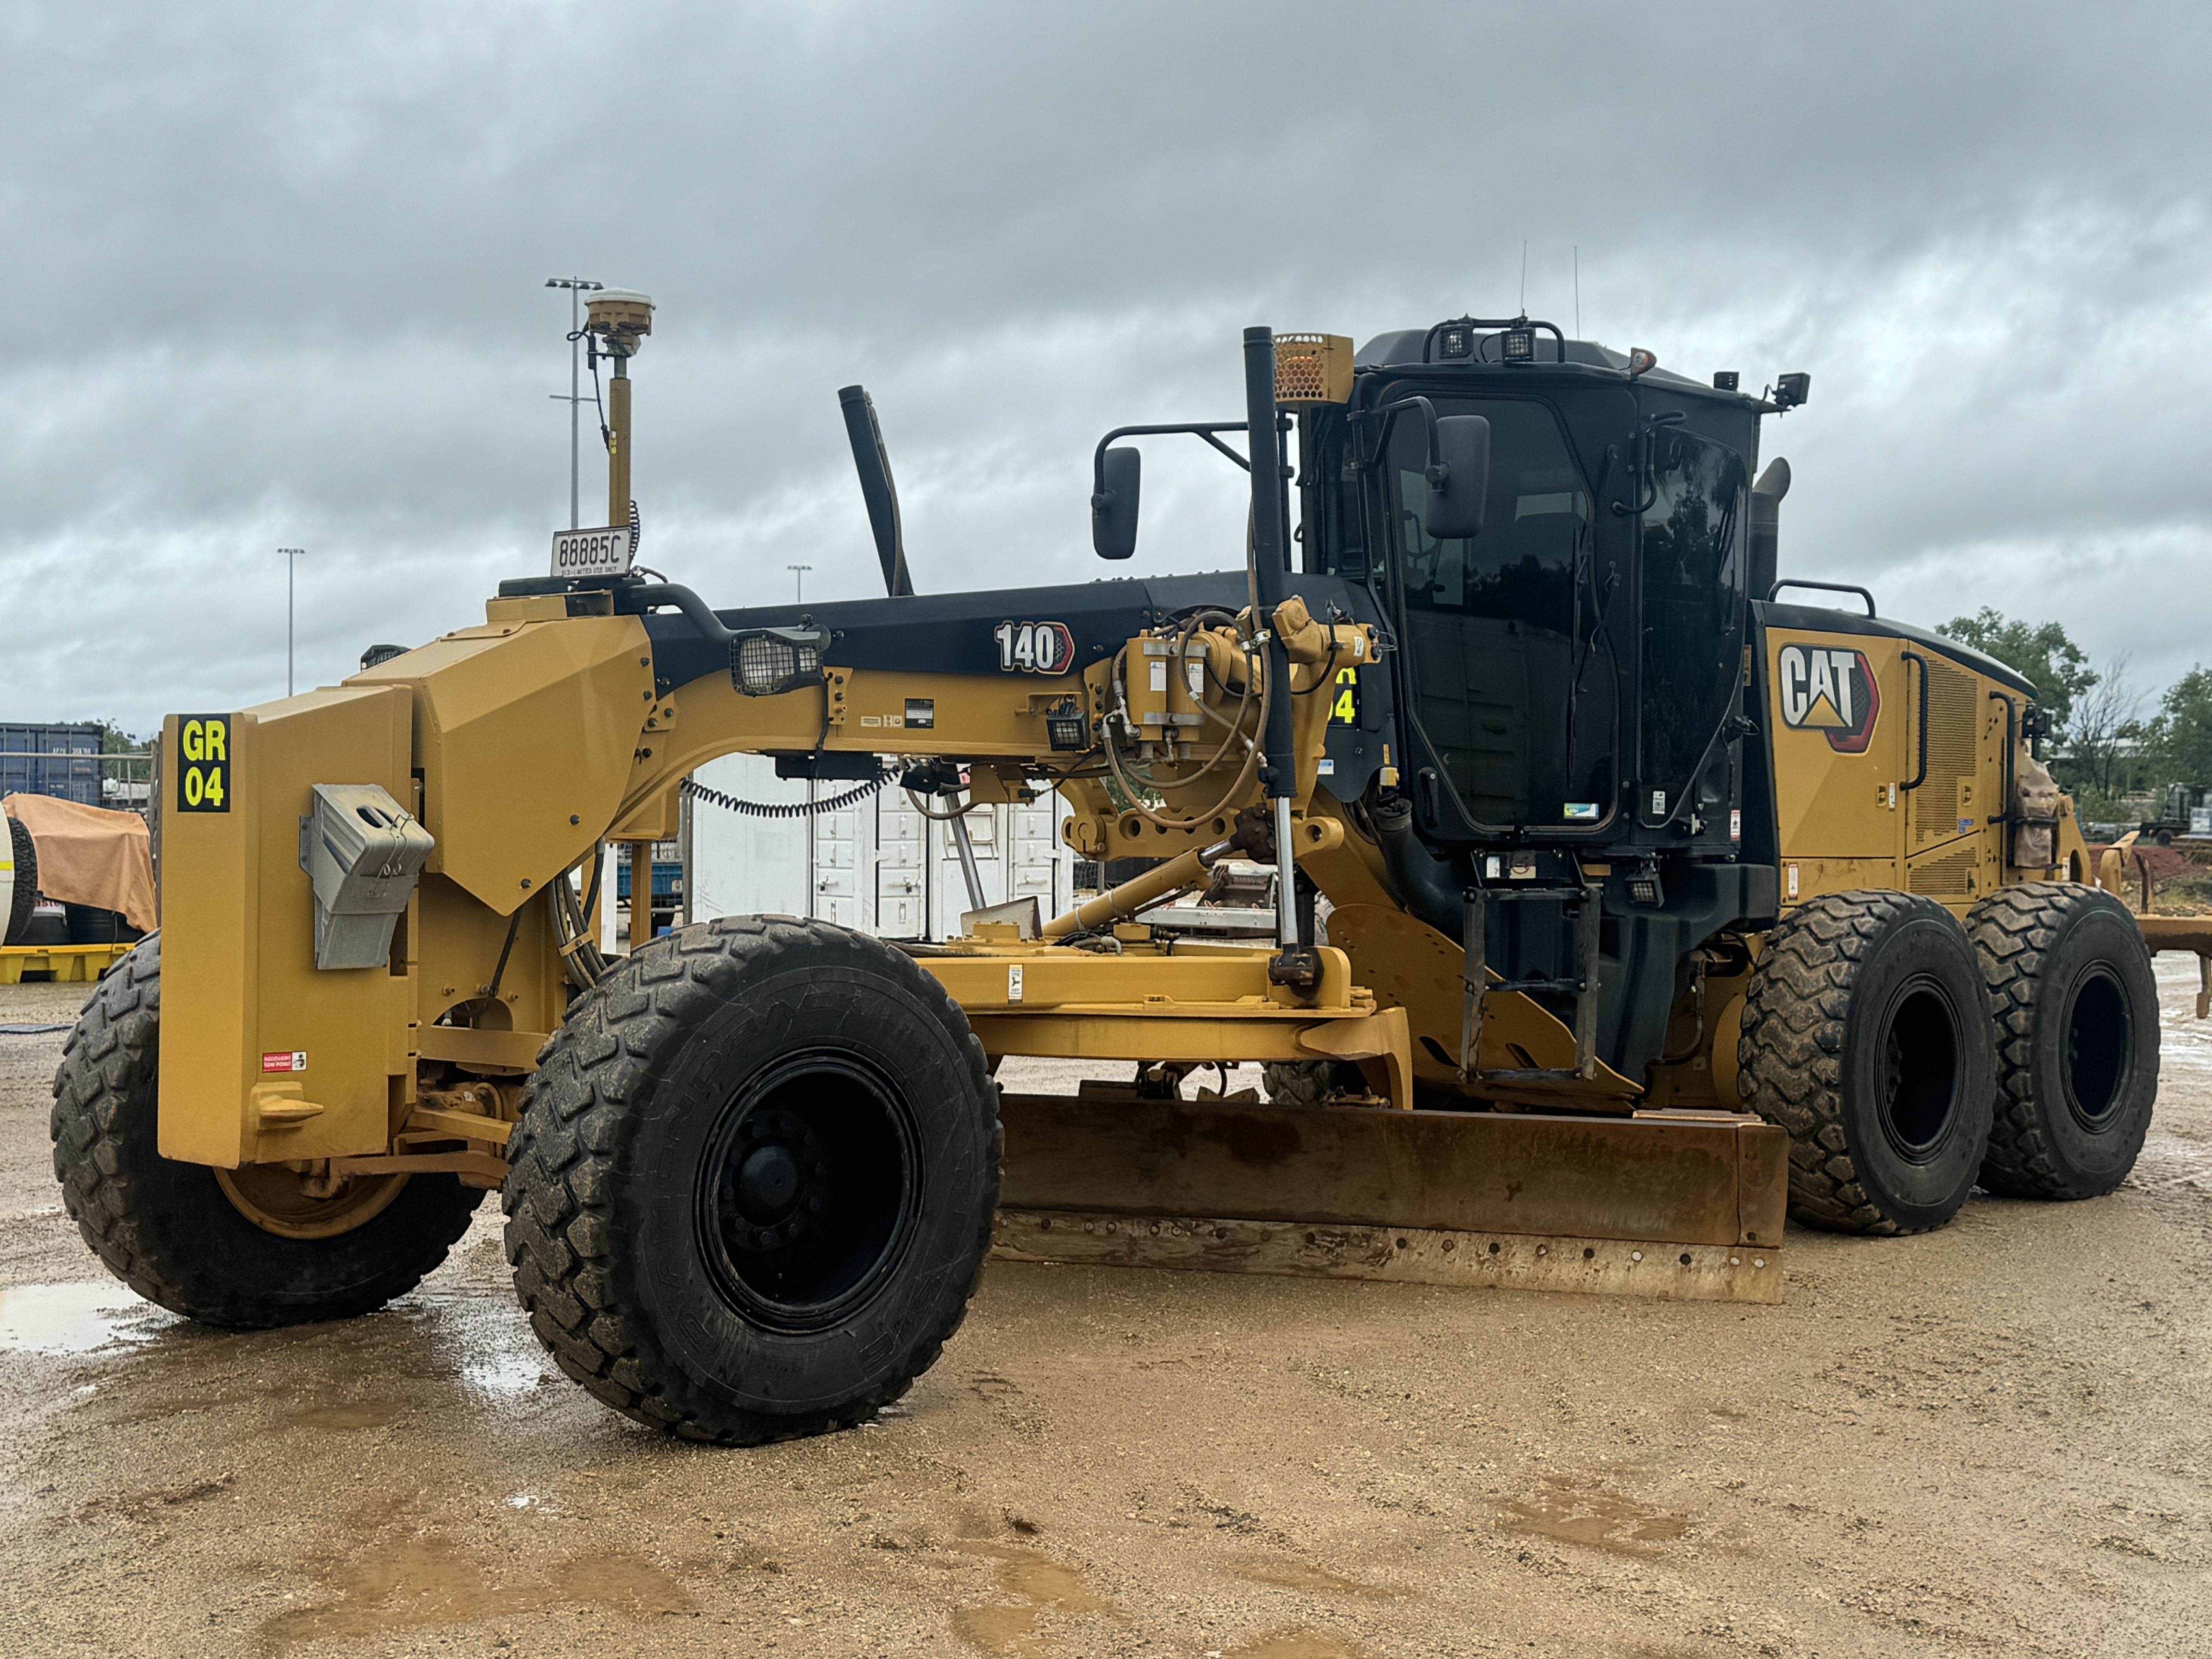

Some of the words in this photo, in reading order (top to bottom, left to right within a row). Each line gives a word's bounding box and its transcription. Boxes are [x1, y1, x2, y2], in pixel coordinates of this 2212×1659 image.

[559, 535, 621, 567] 88885C
[997, 624, 1054, 669] 140
[1328, 690, 1355, 724] 4
[1780, 646, 1855, 727] CAT
[183, 720, 226, 761] GR
[185, 766, 224, 807] 04
